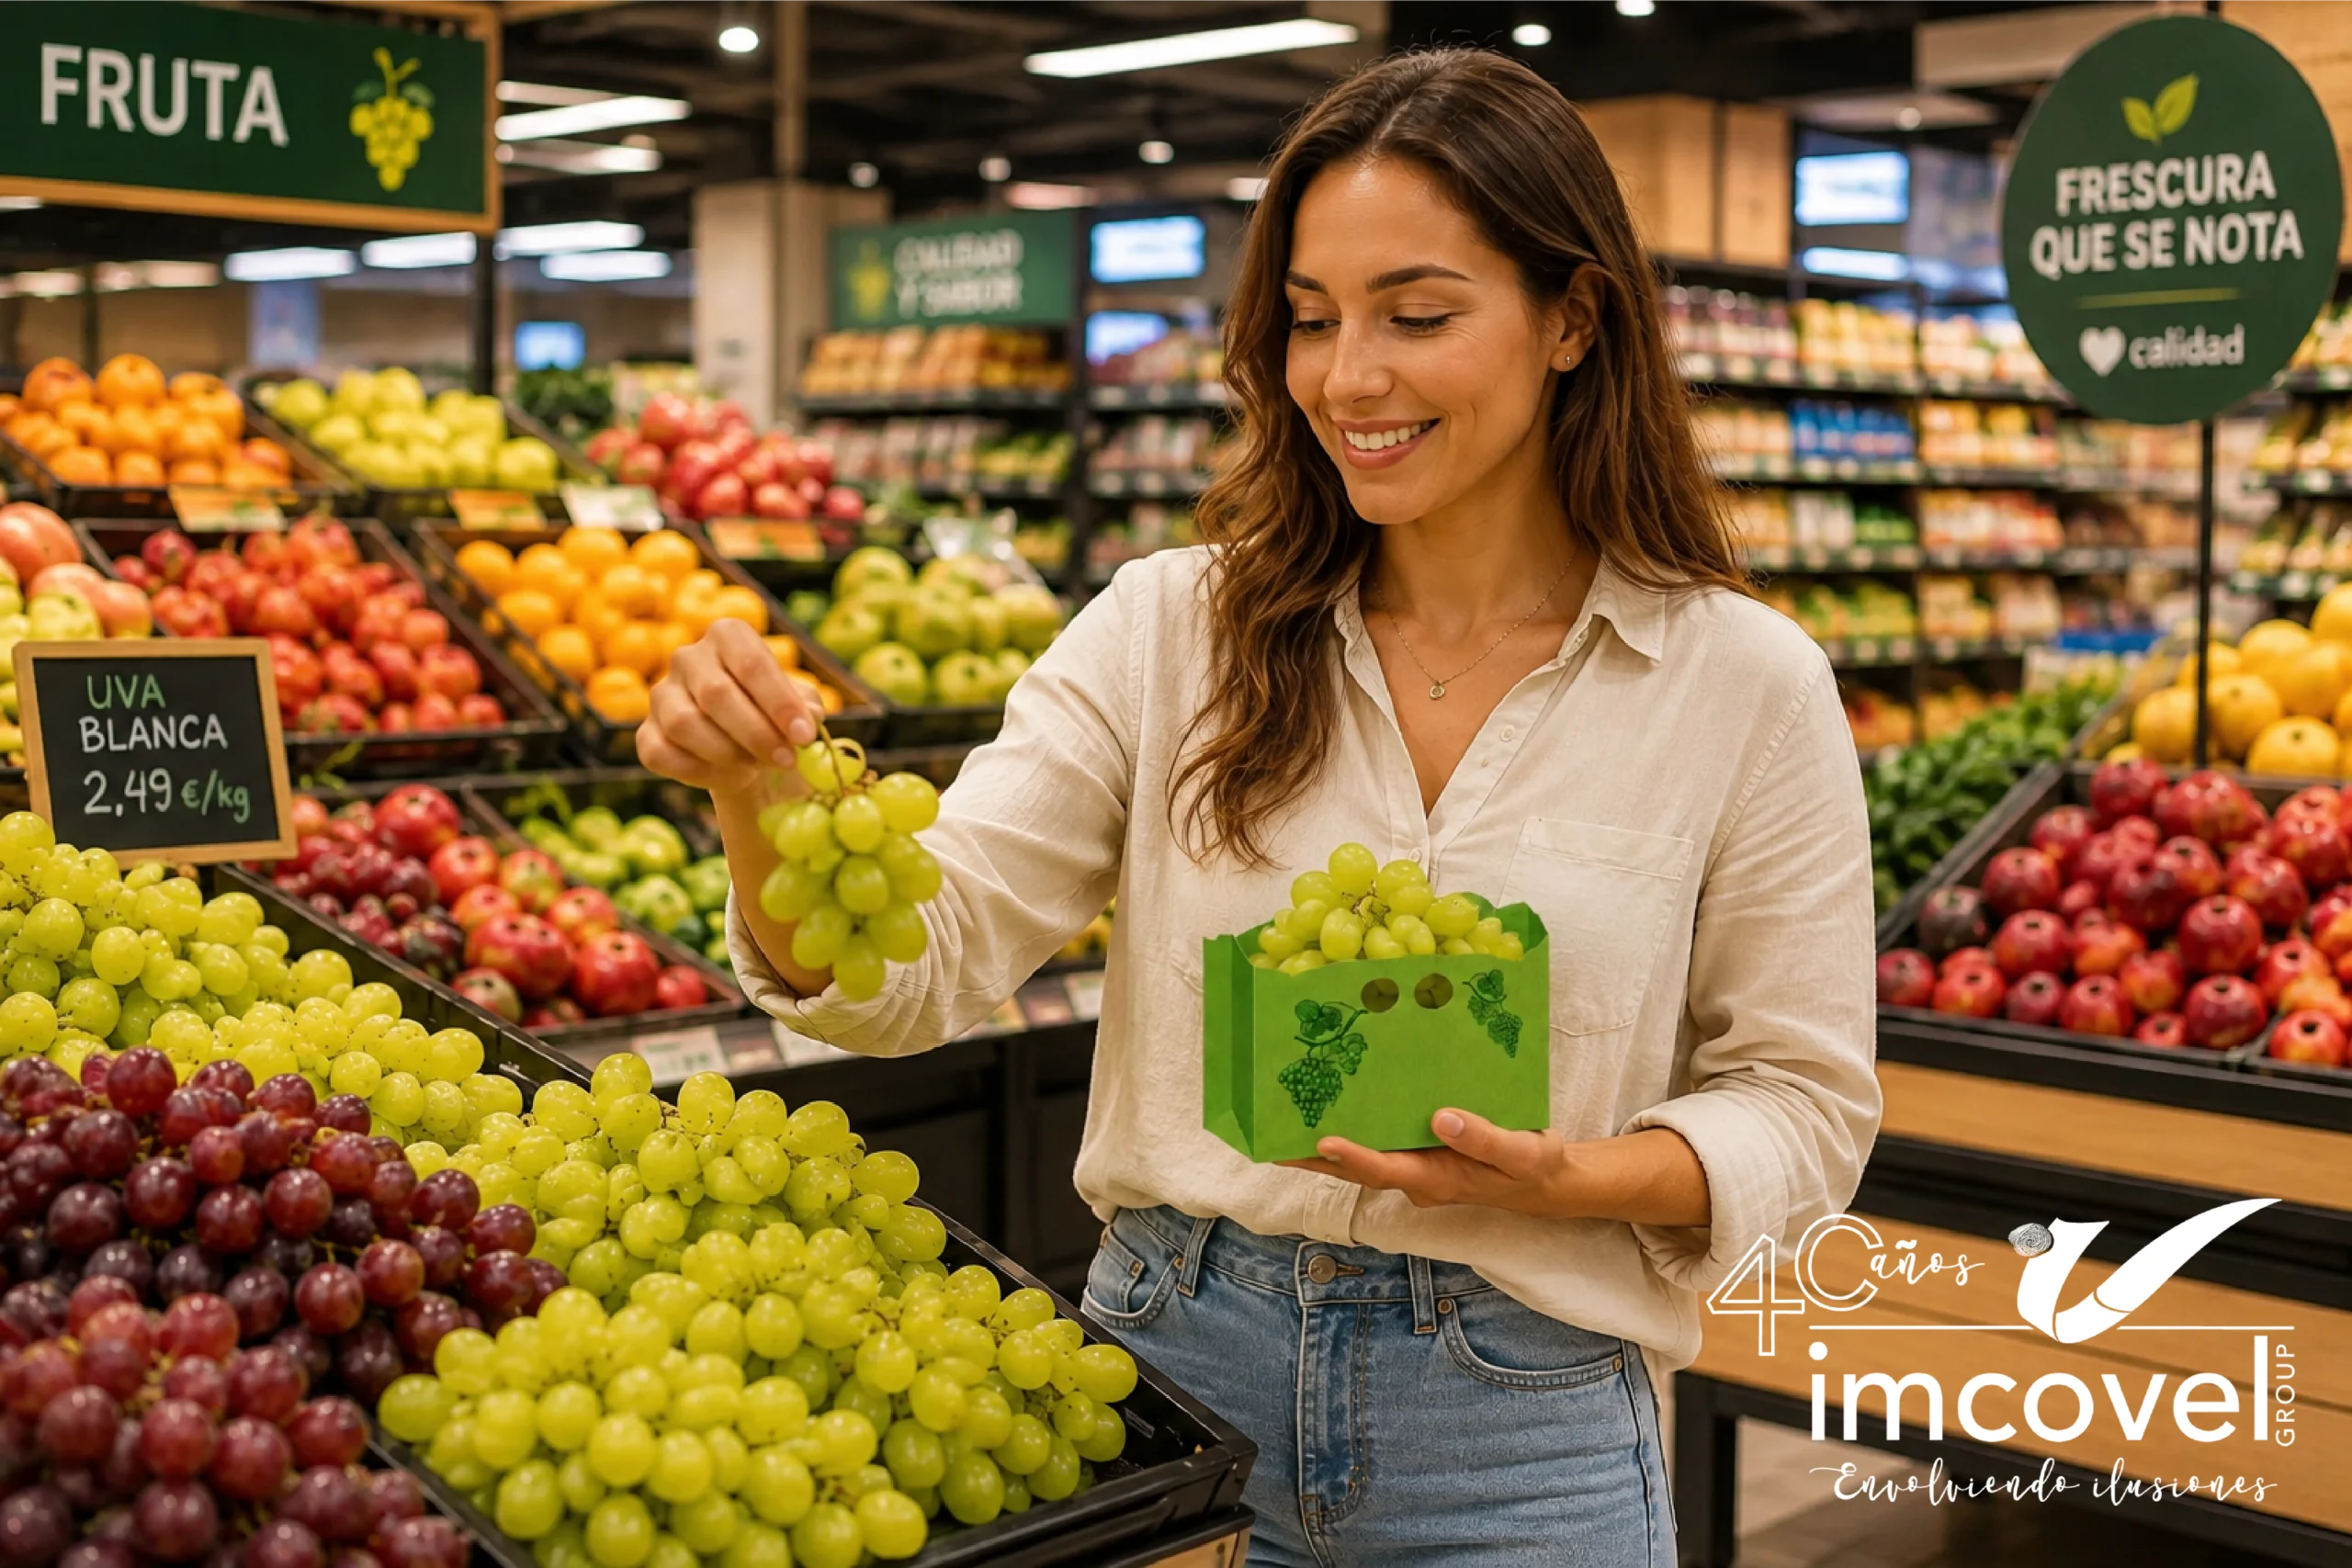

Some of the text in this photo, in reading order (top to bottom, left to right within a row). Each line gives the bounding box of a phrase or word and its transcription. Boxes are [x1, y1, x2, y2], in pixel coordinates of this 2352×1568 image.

[39, 42, 289, 148] FRUTA
[2055, 150, 2278, 218] FRESCURA
[2030, 209, 2304, 281] QUE SE NOTA
[2129, 322, 2245, 369] calidad
[86, 673, 166, 710] UVA
[78, 714, 229, 753] BLANCA
[180, 769, 251, 824] €/kg
